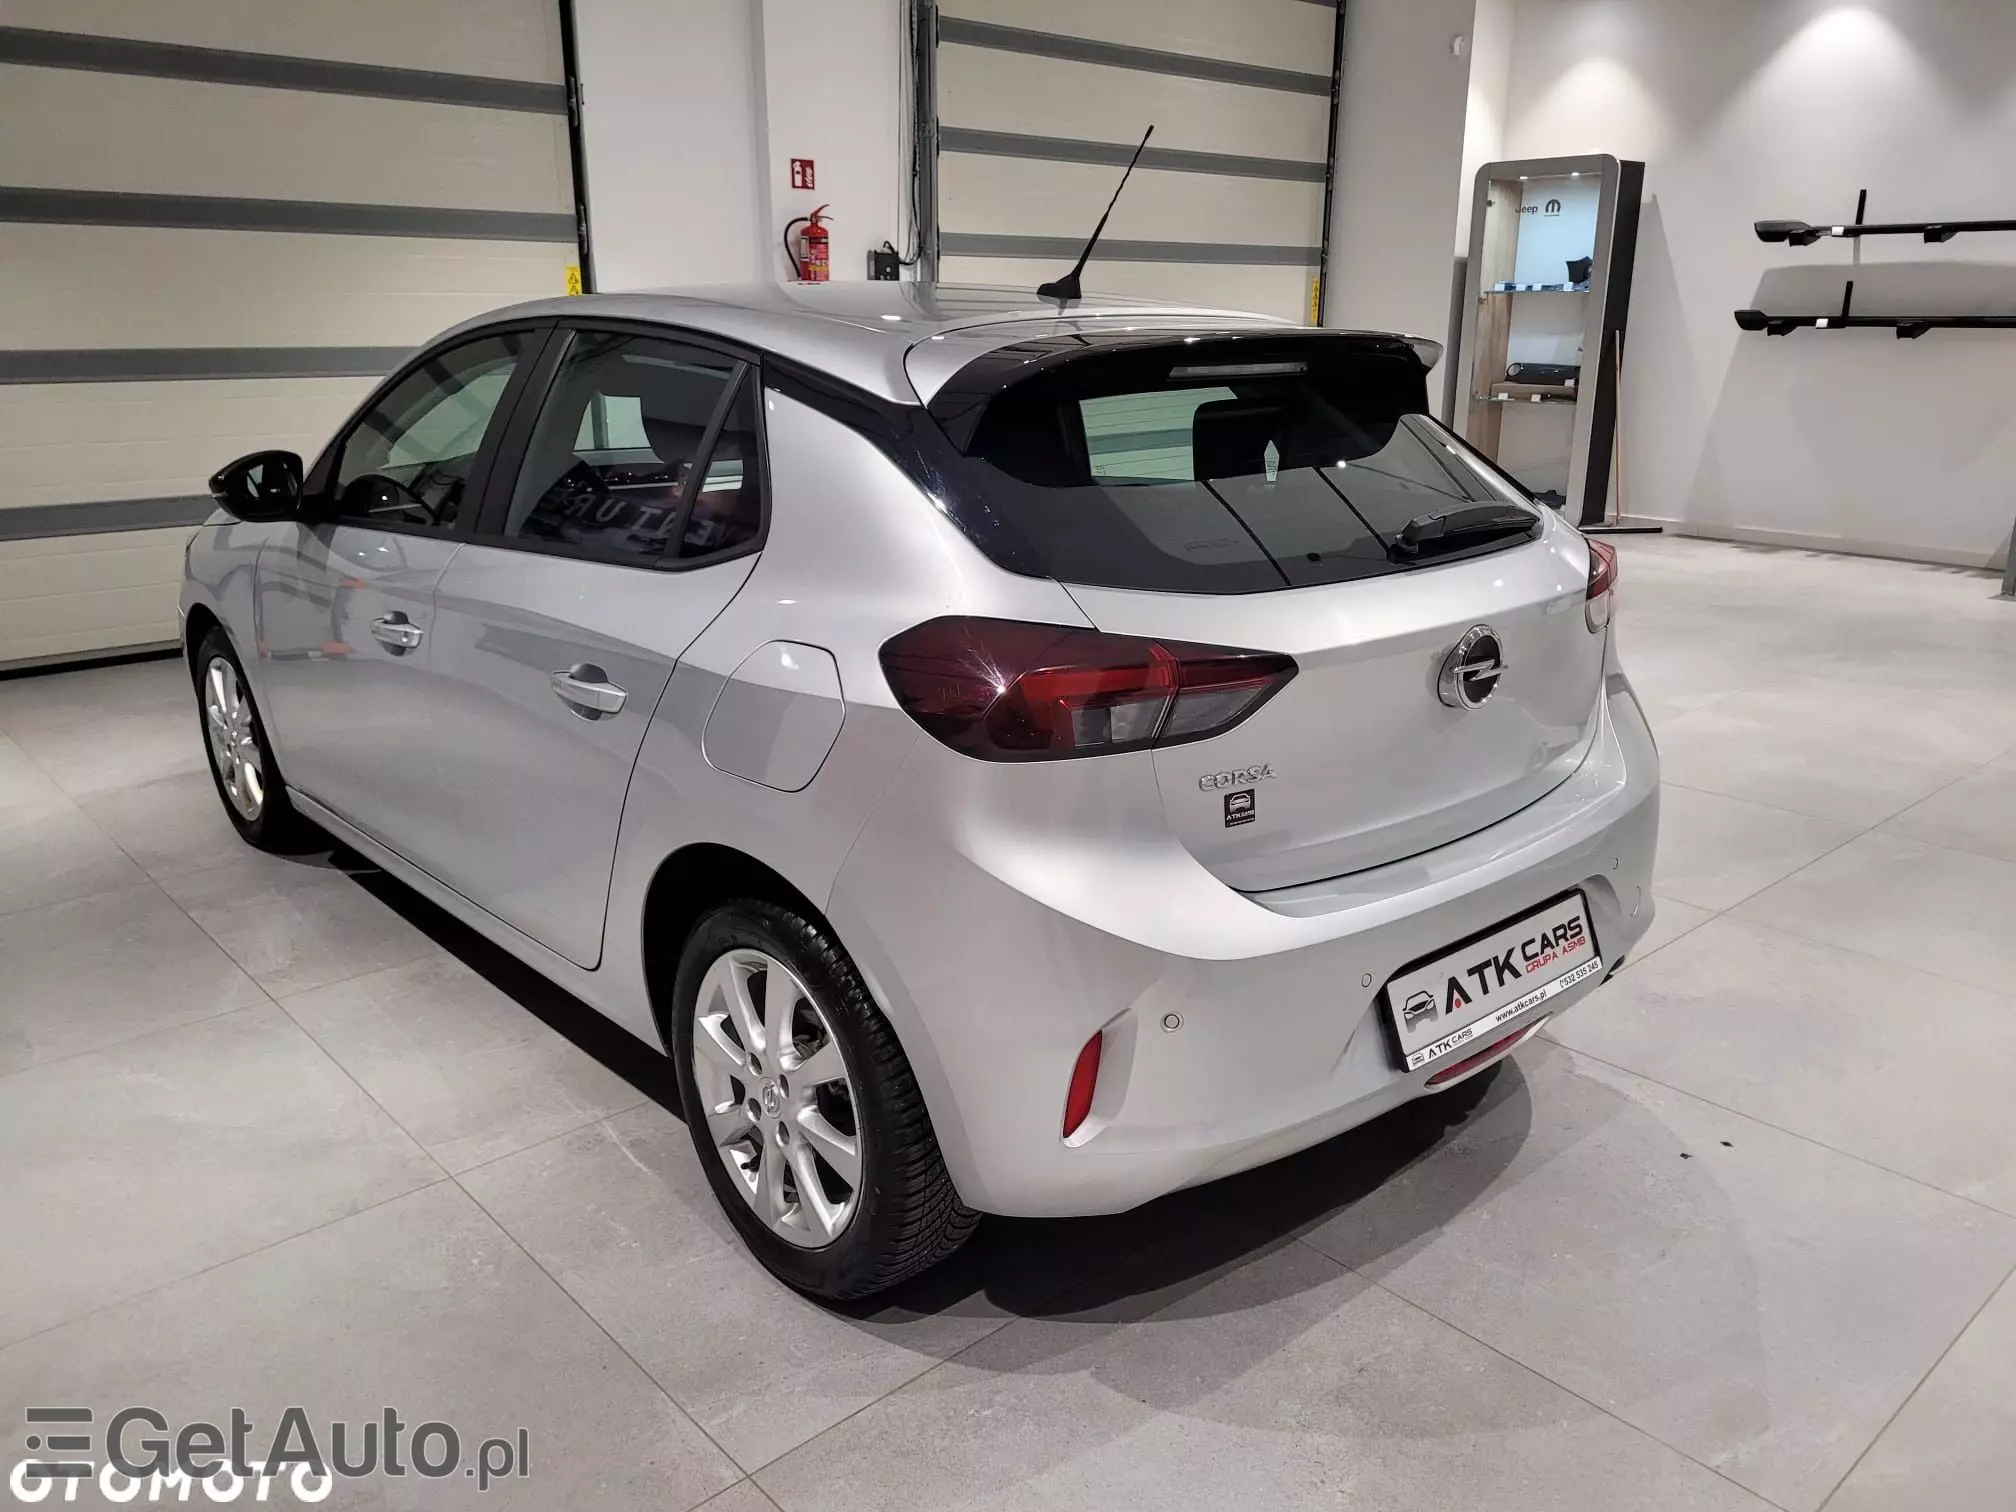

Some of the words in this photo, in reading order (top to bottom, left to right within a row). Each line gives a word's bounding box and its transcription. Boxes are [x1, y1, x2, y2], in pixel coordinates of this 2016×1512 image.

[1199, 764, 1277, 792] CORSA
[1445, 946, 1522, 1015] ATK
[1521, 915, 1583, 962] CARS
[1526, 951, 1558, 973] GRUPA
[1562, 935, 1586, 955] ASMB
[1429, 1038, 1452, 1059] ATK
[1451, 1028, 1473, 1043] CARS
[1495, 989, 1548, 1023] www.atkcars.pl
[1575, 967, 1588, 979] 535
[1587, 960, 1599, 972] 245
